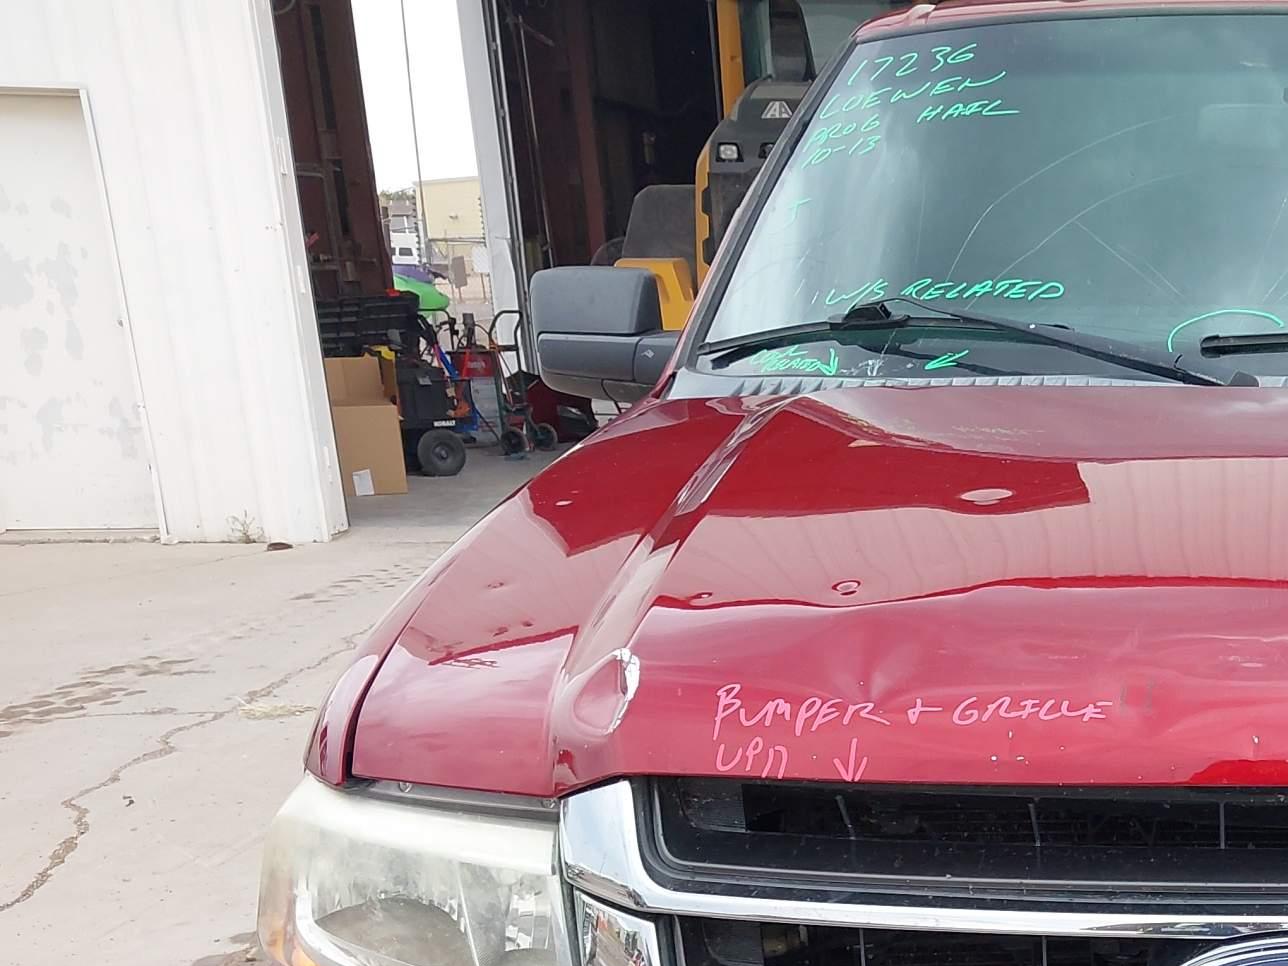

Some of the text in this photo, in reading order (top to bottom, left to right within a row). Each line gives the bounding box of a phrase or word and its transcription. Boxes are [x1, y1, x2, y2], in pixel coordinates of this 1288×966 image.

[848, 43, 977, 86] 17236
[900, 278, 1065, 301] RELATED
[713, 683, 891, 740] BUMPER
[952, 697, 1114, 725] GRILLE
